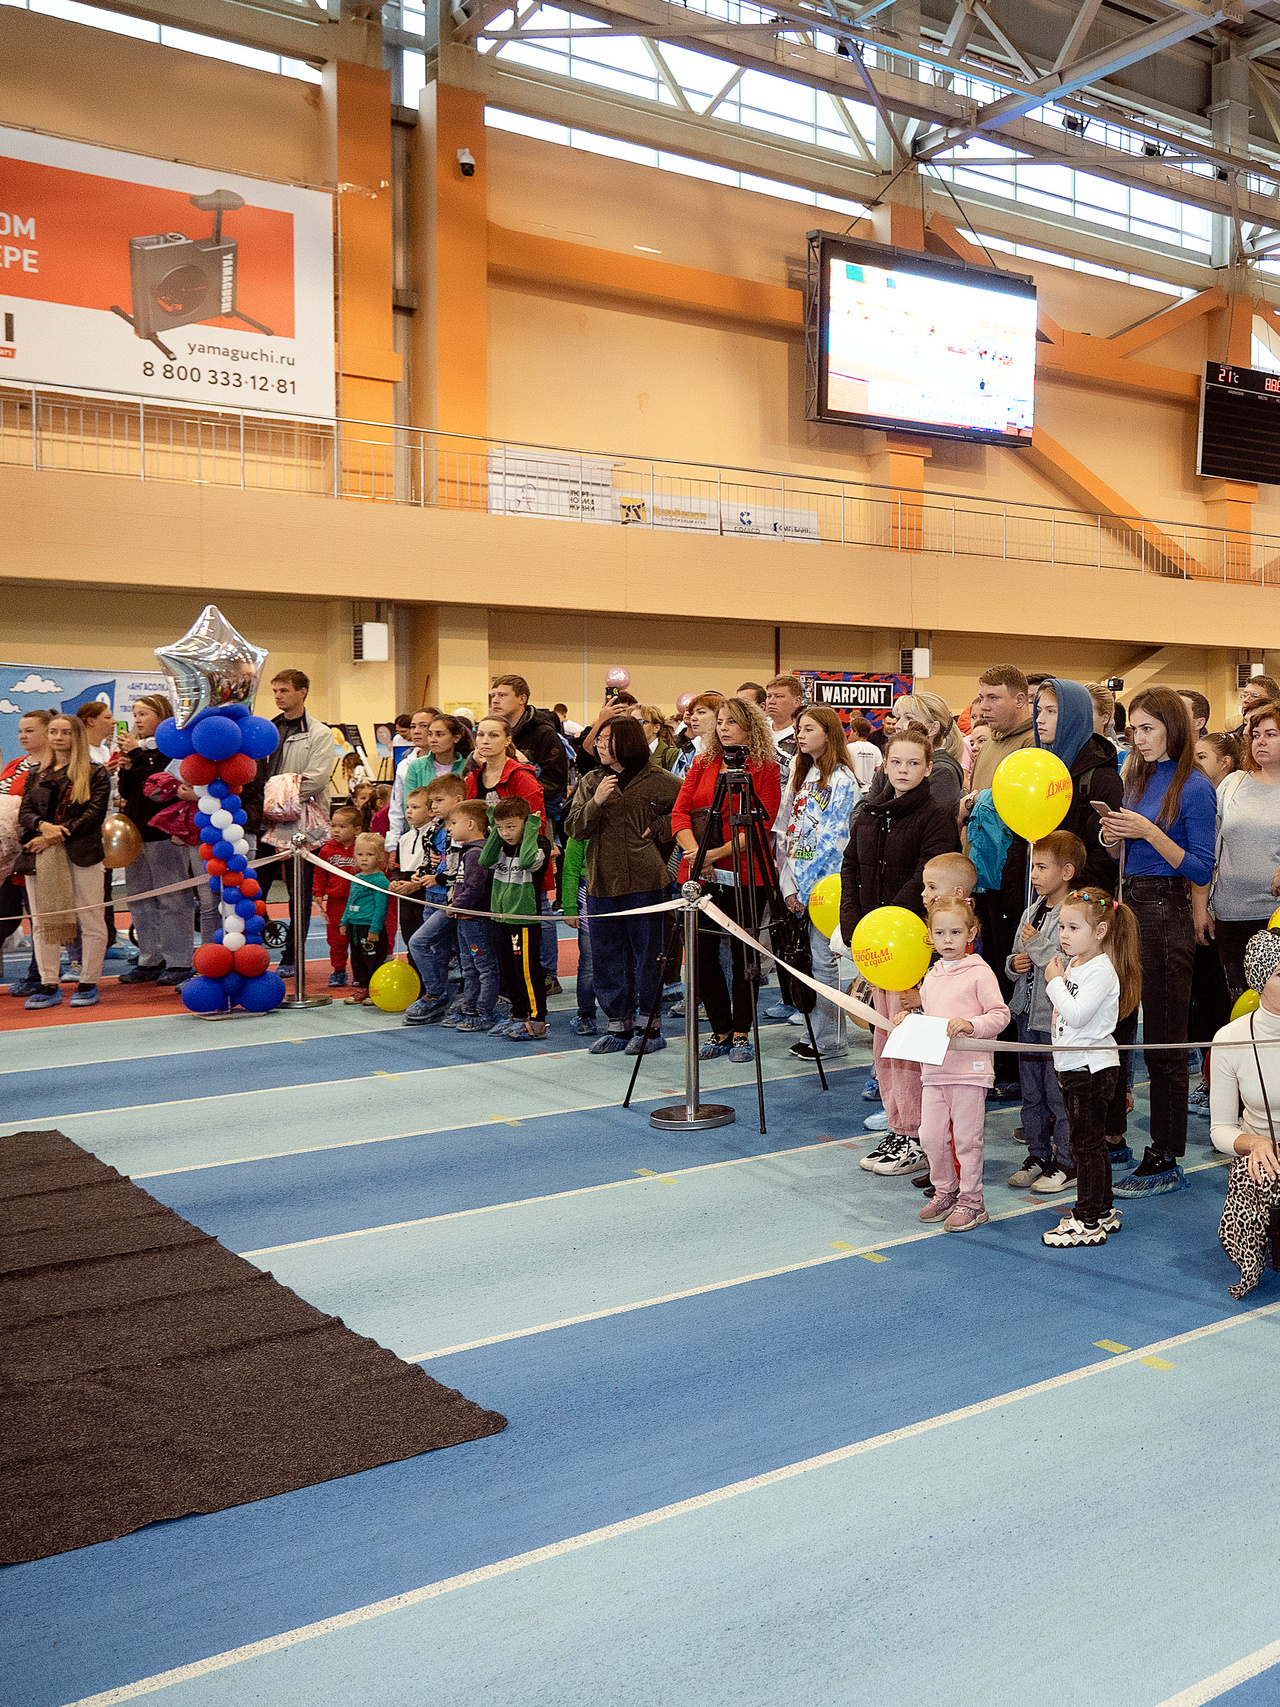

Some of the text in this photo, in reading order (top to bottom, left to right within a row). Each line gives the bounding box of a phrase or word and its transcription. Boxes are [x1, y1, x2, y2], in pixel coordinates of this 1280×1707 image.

[0, 245, 39, 273] РЕ
[188, 342, 295, 366] yamaguchi.ru
[143, 361, 155, 377] 8
[162, 364, 201, 383] 800
[821, 685, 887, 704] WARPOINT
